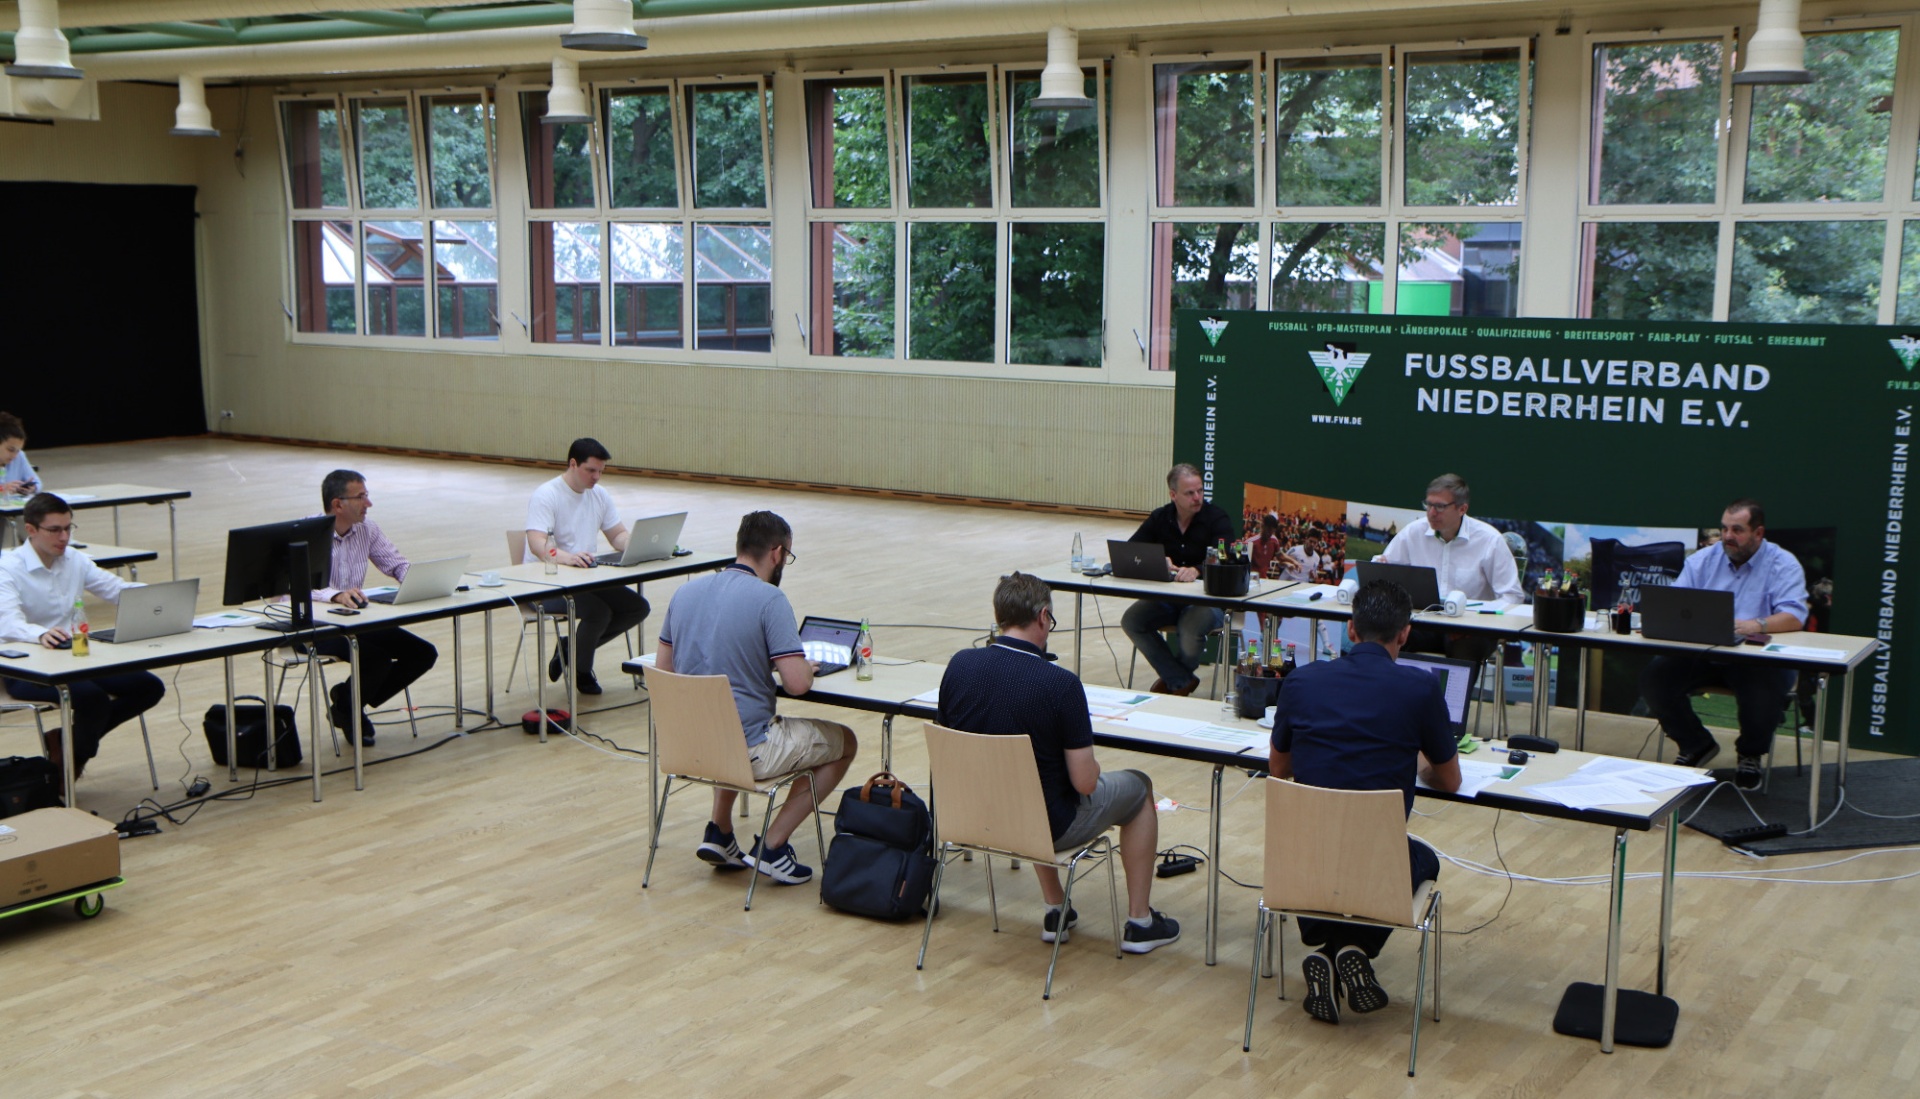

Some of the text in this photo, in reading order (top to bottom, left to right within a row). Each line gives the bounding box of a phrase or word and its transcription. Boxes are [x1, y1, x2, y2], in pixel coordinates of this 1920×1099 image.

[1268, 322, 1827, 347] FUSSBALL DFB-MASTERPLAN LÄNDERPOKALE QUALIFIZIERUNG BREITENSPORT FAIR-PLAY FUTSAL EHRENAMT
[1199, 354, 1227, 364] FVN.DE
[1404, 352, 1771, 391] FUSSBALLVERBAND
[1206, 374, 1218, 401] E.V.
[1311, 414, 1363, 426] WWW.FVN.DE
[1417, 387, 1750, 428] NIEDERRHEIN E.V.
[1870, 404, 1913, 736] FUSSBALLVERBAND NIEDERRHEIN E.V.
